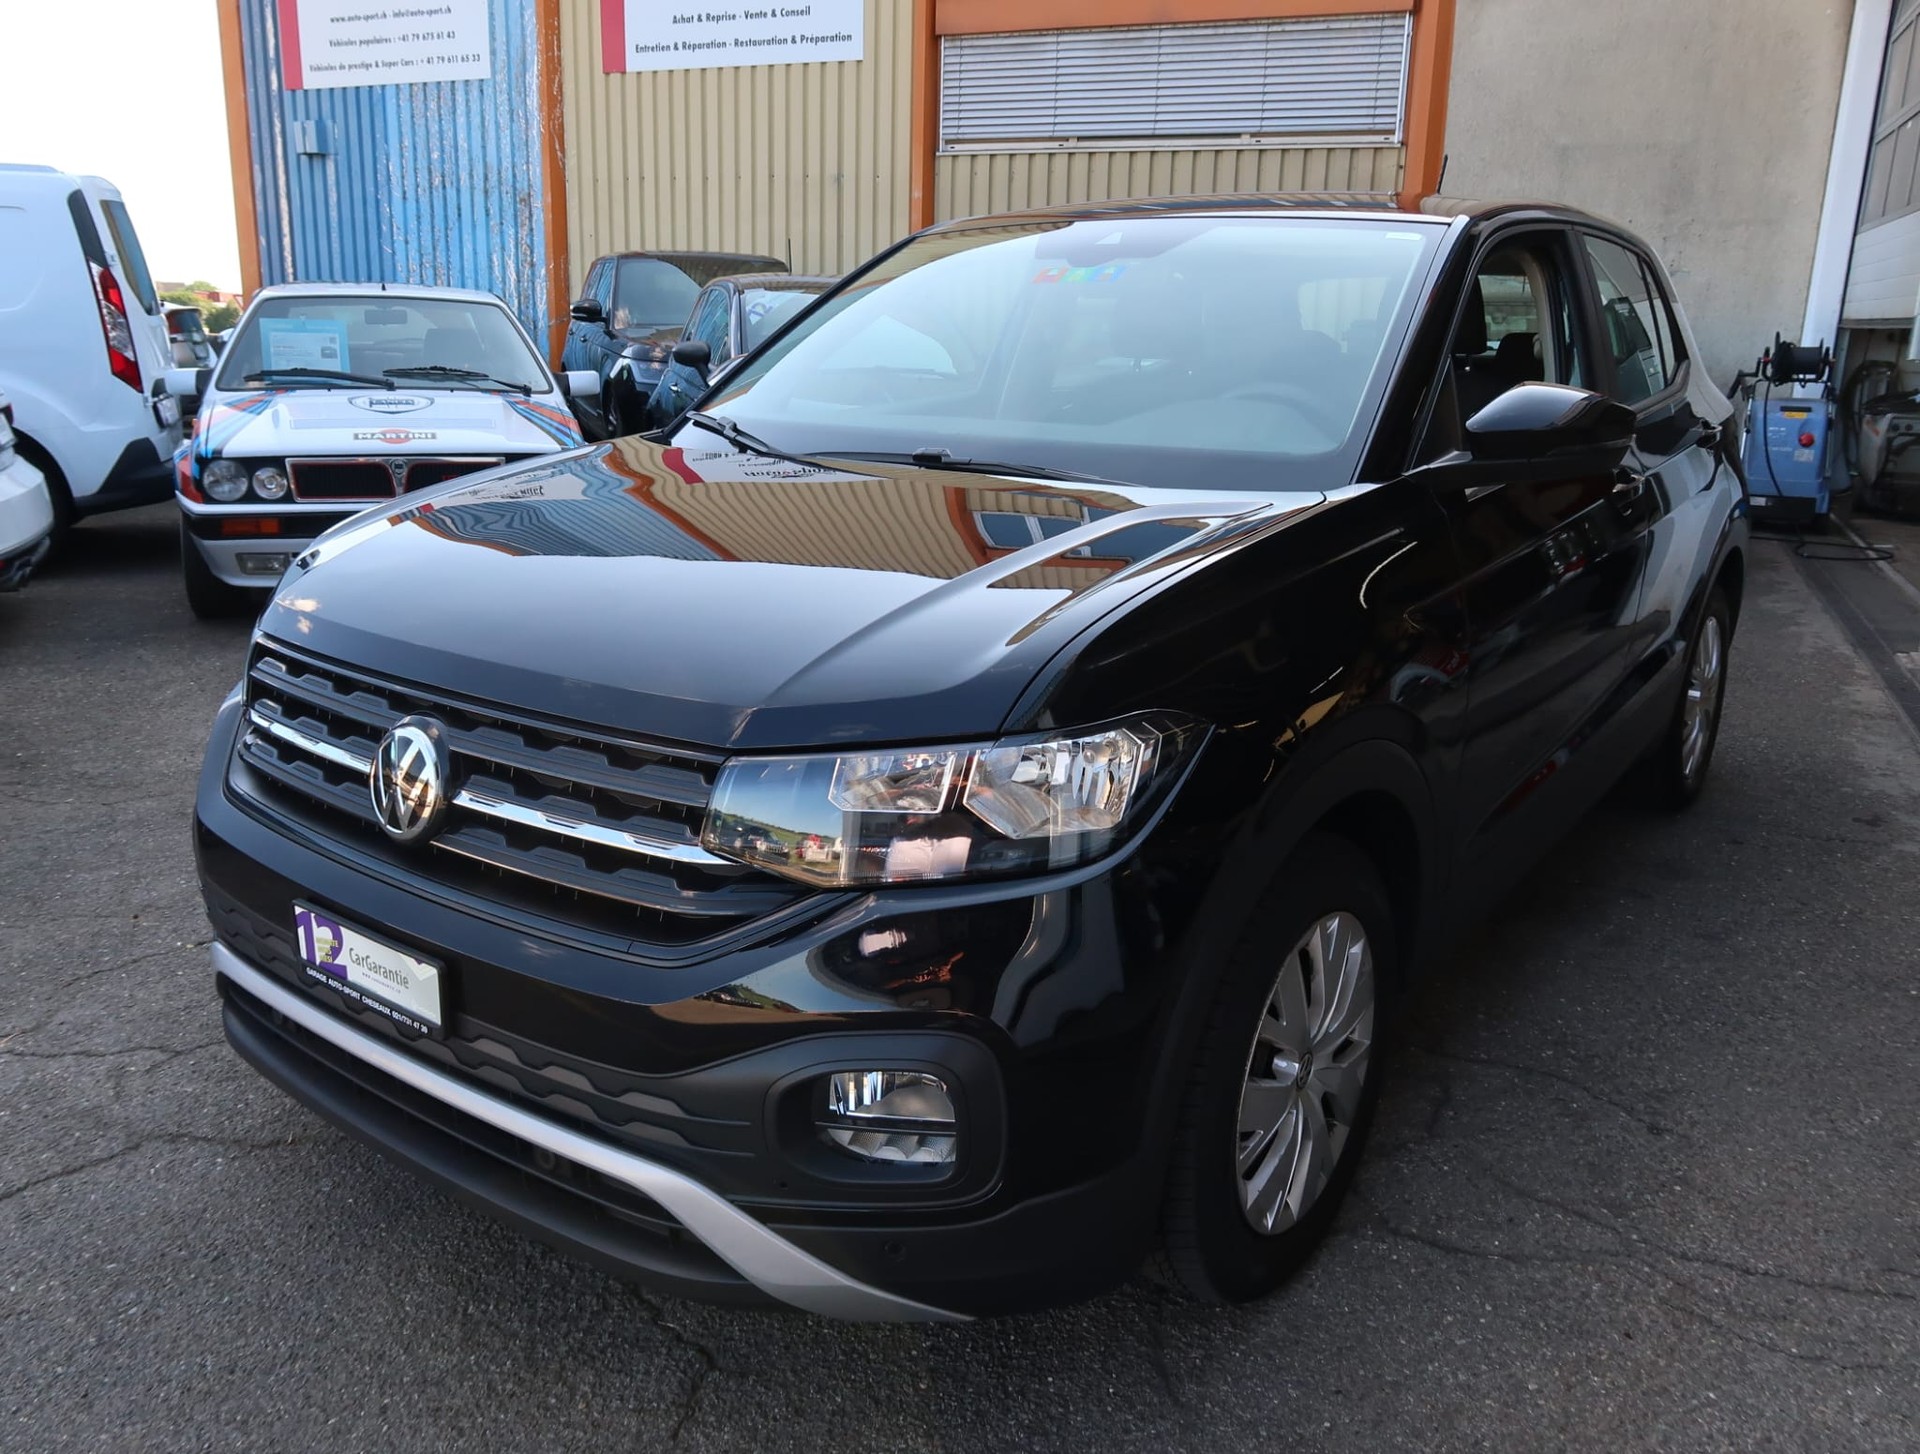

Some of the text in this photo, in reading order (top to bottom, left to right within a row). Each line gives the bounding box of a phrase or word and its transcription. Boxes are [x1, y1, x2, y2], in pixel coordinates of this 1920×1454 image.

[672, 14, 694, 24] Achat
[697, 13, 703, 23] &
[705, 11, 737, 25] Reprise
[744, 10, 768, 20] Vente
[771, 8, 777, 18] &
[780, 5, 811, 18] Conseil
[359, 35, 392, 48] populaires
[411, 32, 420, 41] 79
[422, 31, 434, 41] 675
[436, 31, 444, 40] 61
[635, 42, 671, 53] Entretien
[673, 41, 679, 51] &
[682, 39, 727, 53] Réparation
[734, 35, 788, 48] Restauration
[791, 34, 797, 44] &
[800, 31, 853, 46] Préparation
[339, 62, 346, 71] de
[348, 60, 373, 72] prestige
[375, 60, 380, 68] &
[381, 59, 399, 70] Super
[400, 58, 414, 67] Cars
[436, 55, 445, 64] 79
[358, 431, 435, 440] MARTINI
[349, 947, 410, 989] CarGarantie
